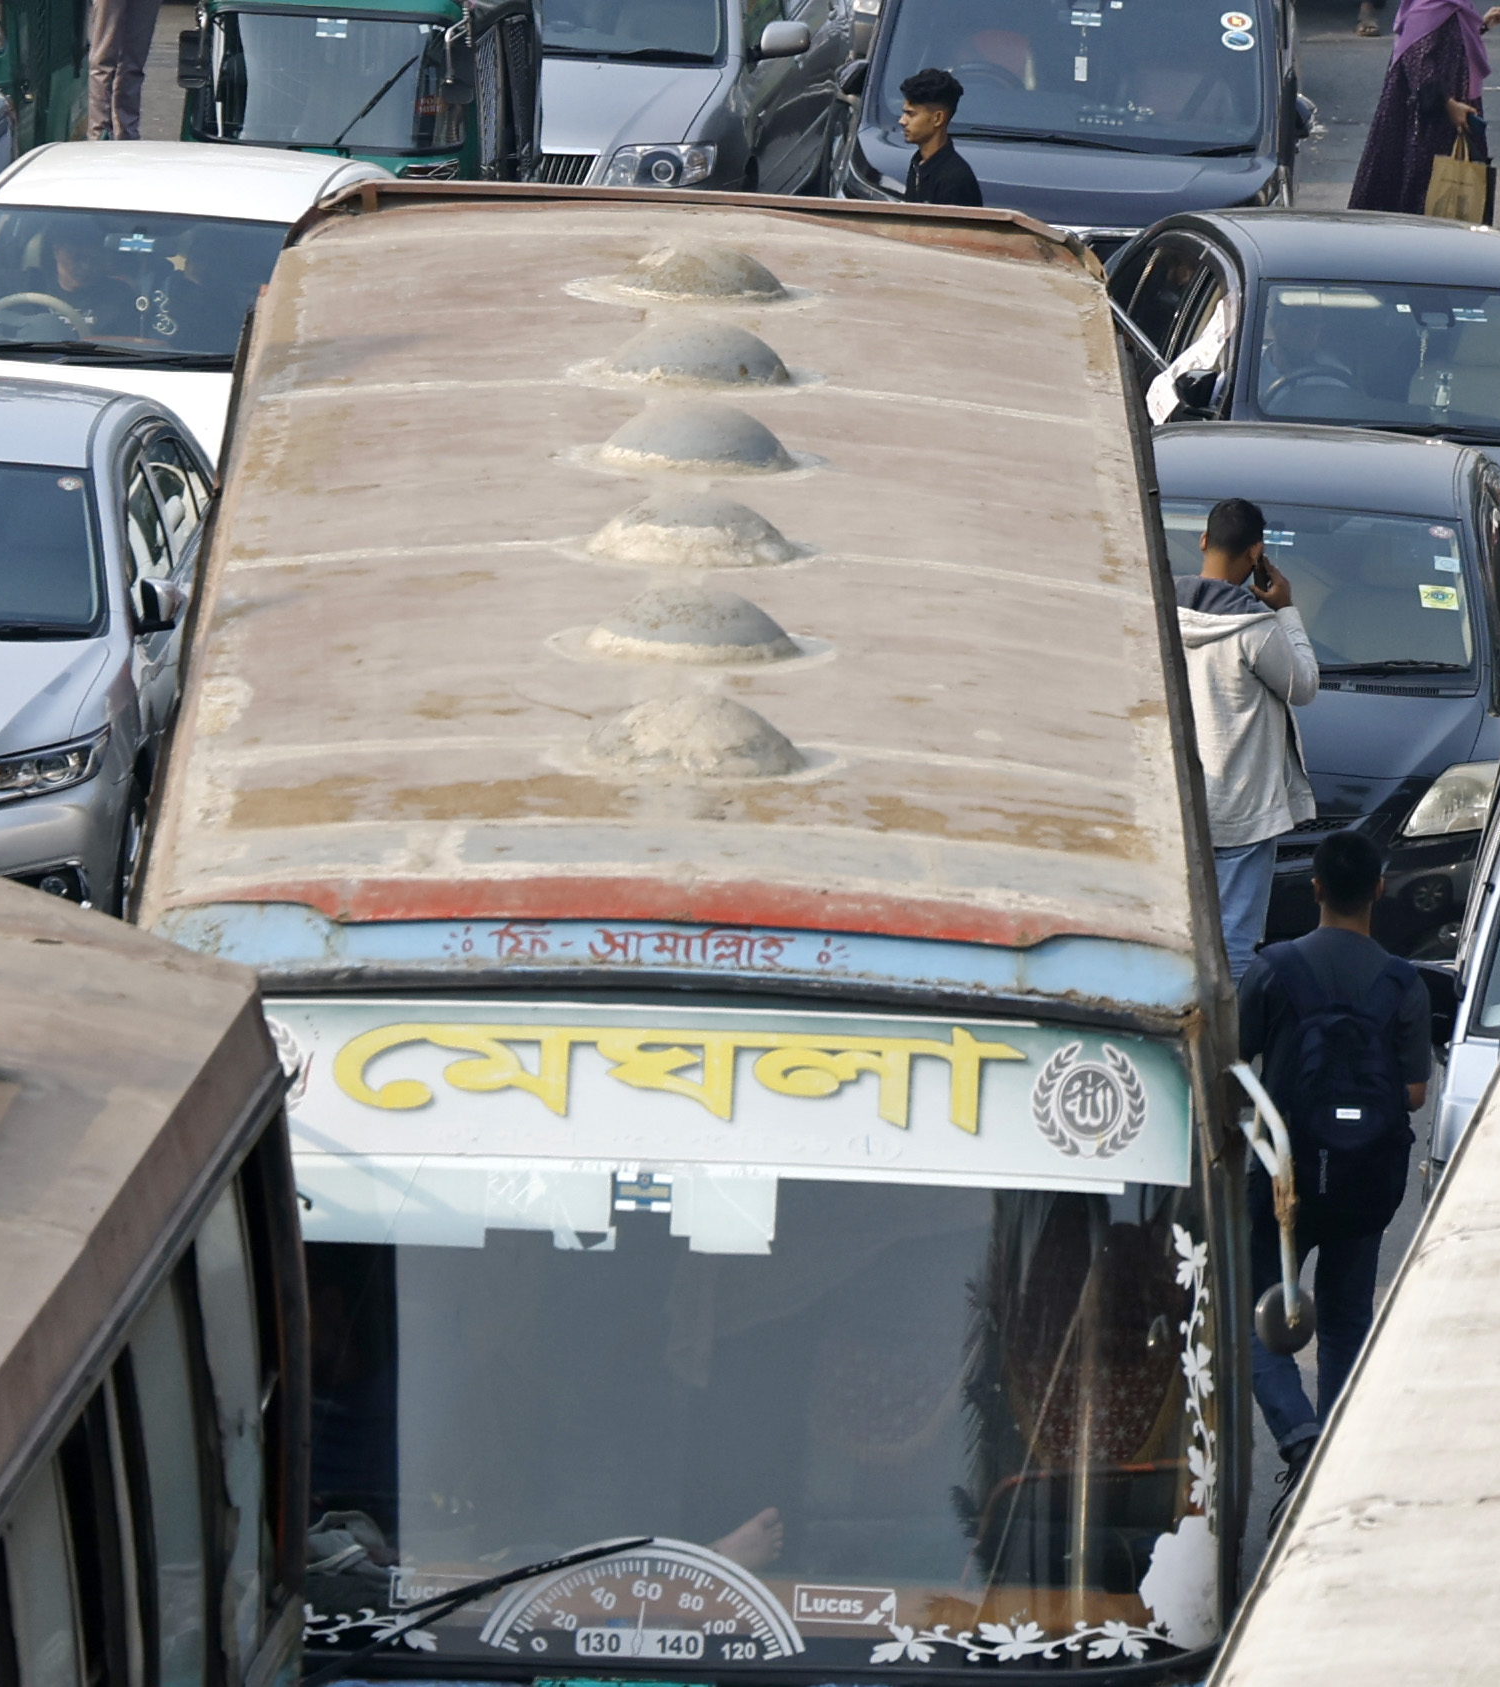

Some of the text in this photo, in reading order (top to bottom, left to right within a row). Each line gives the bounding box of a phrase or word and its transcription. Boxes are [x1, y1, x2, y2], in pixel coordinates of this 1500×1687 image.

[333, 1023, 1027, 1135] মেঘলা
[590, 1586, 617, 1610] 40
[631, 1580, 662, 1601] 60
[678, 1592, 705, 1612] 80
[800, 1596, 864, 1615] Lucas
[552, 1611, 577, 1632] 20
[702, 1618, 737, 1636] 100
[532, 1637, 548, 1653] 0
[580, 1634, 699, 1656] 130 140
[721, 1642, 757, 1660] 120
